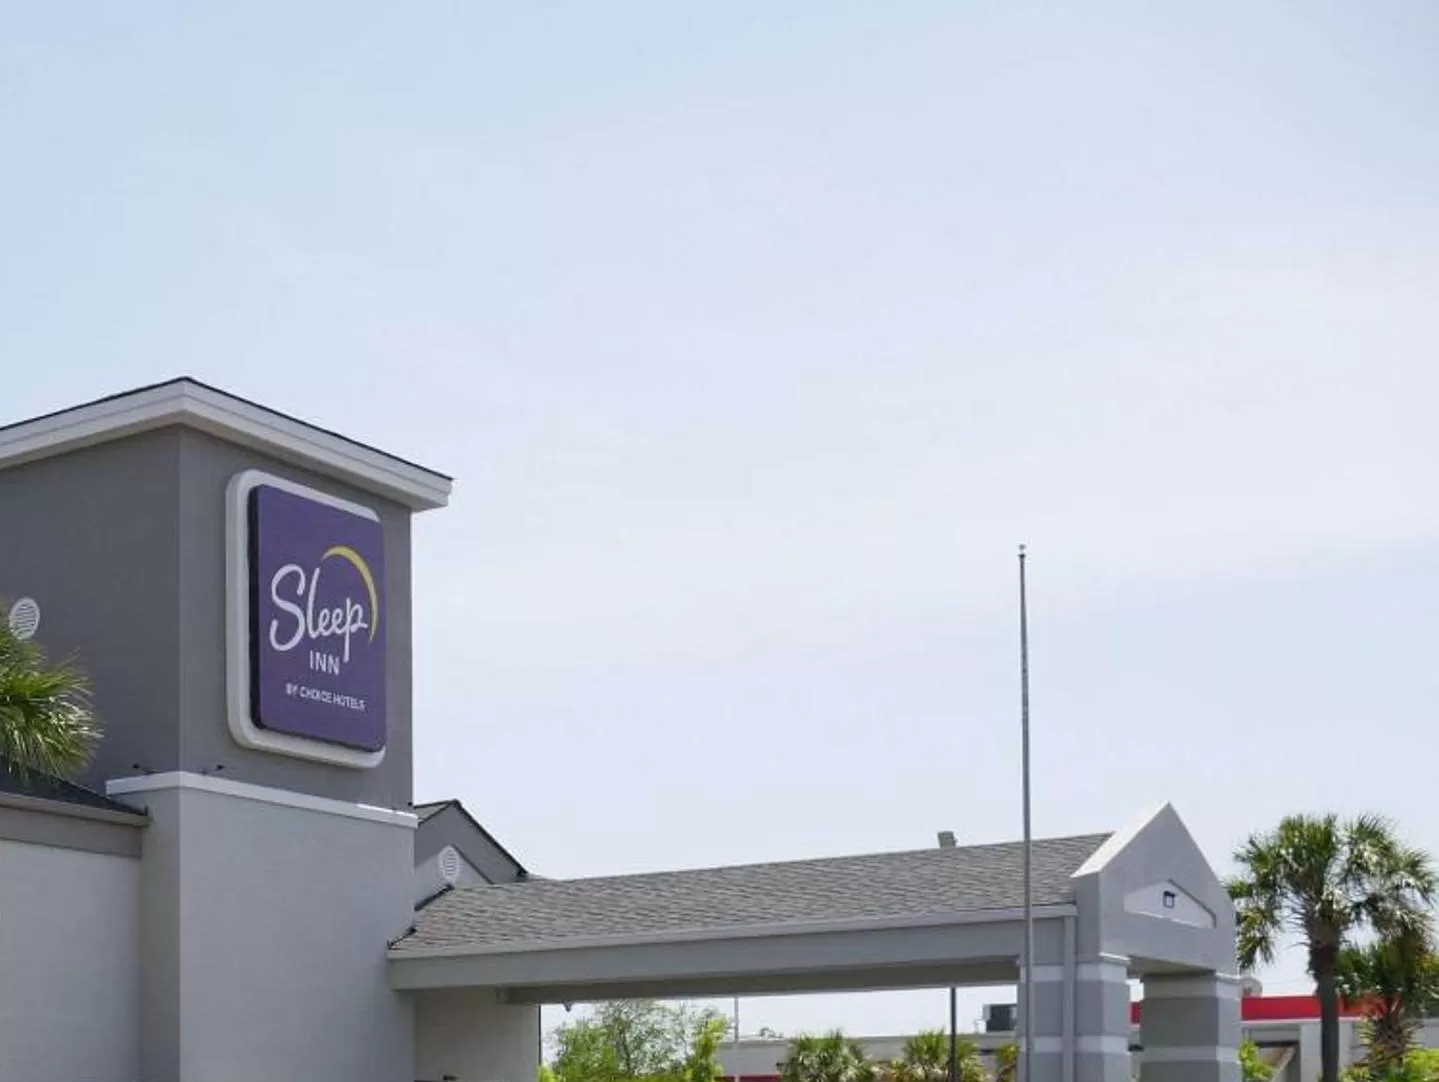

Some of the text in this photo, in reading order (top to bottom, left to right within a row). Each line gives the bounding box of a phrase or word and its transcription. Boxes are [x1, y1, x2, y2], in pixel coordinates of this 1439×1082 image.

[269, 563, 369, 663] Sleep
[309, 650, 340, 676] INN
[286, 682, 365, 710] BY CHOICE HOTELS
